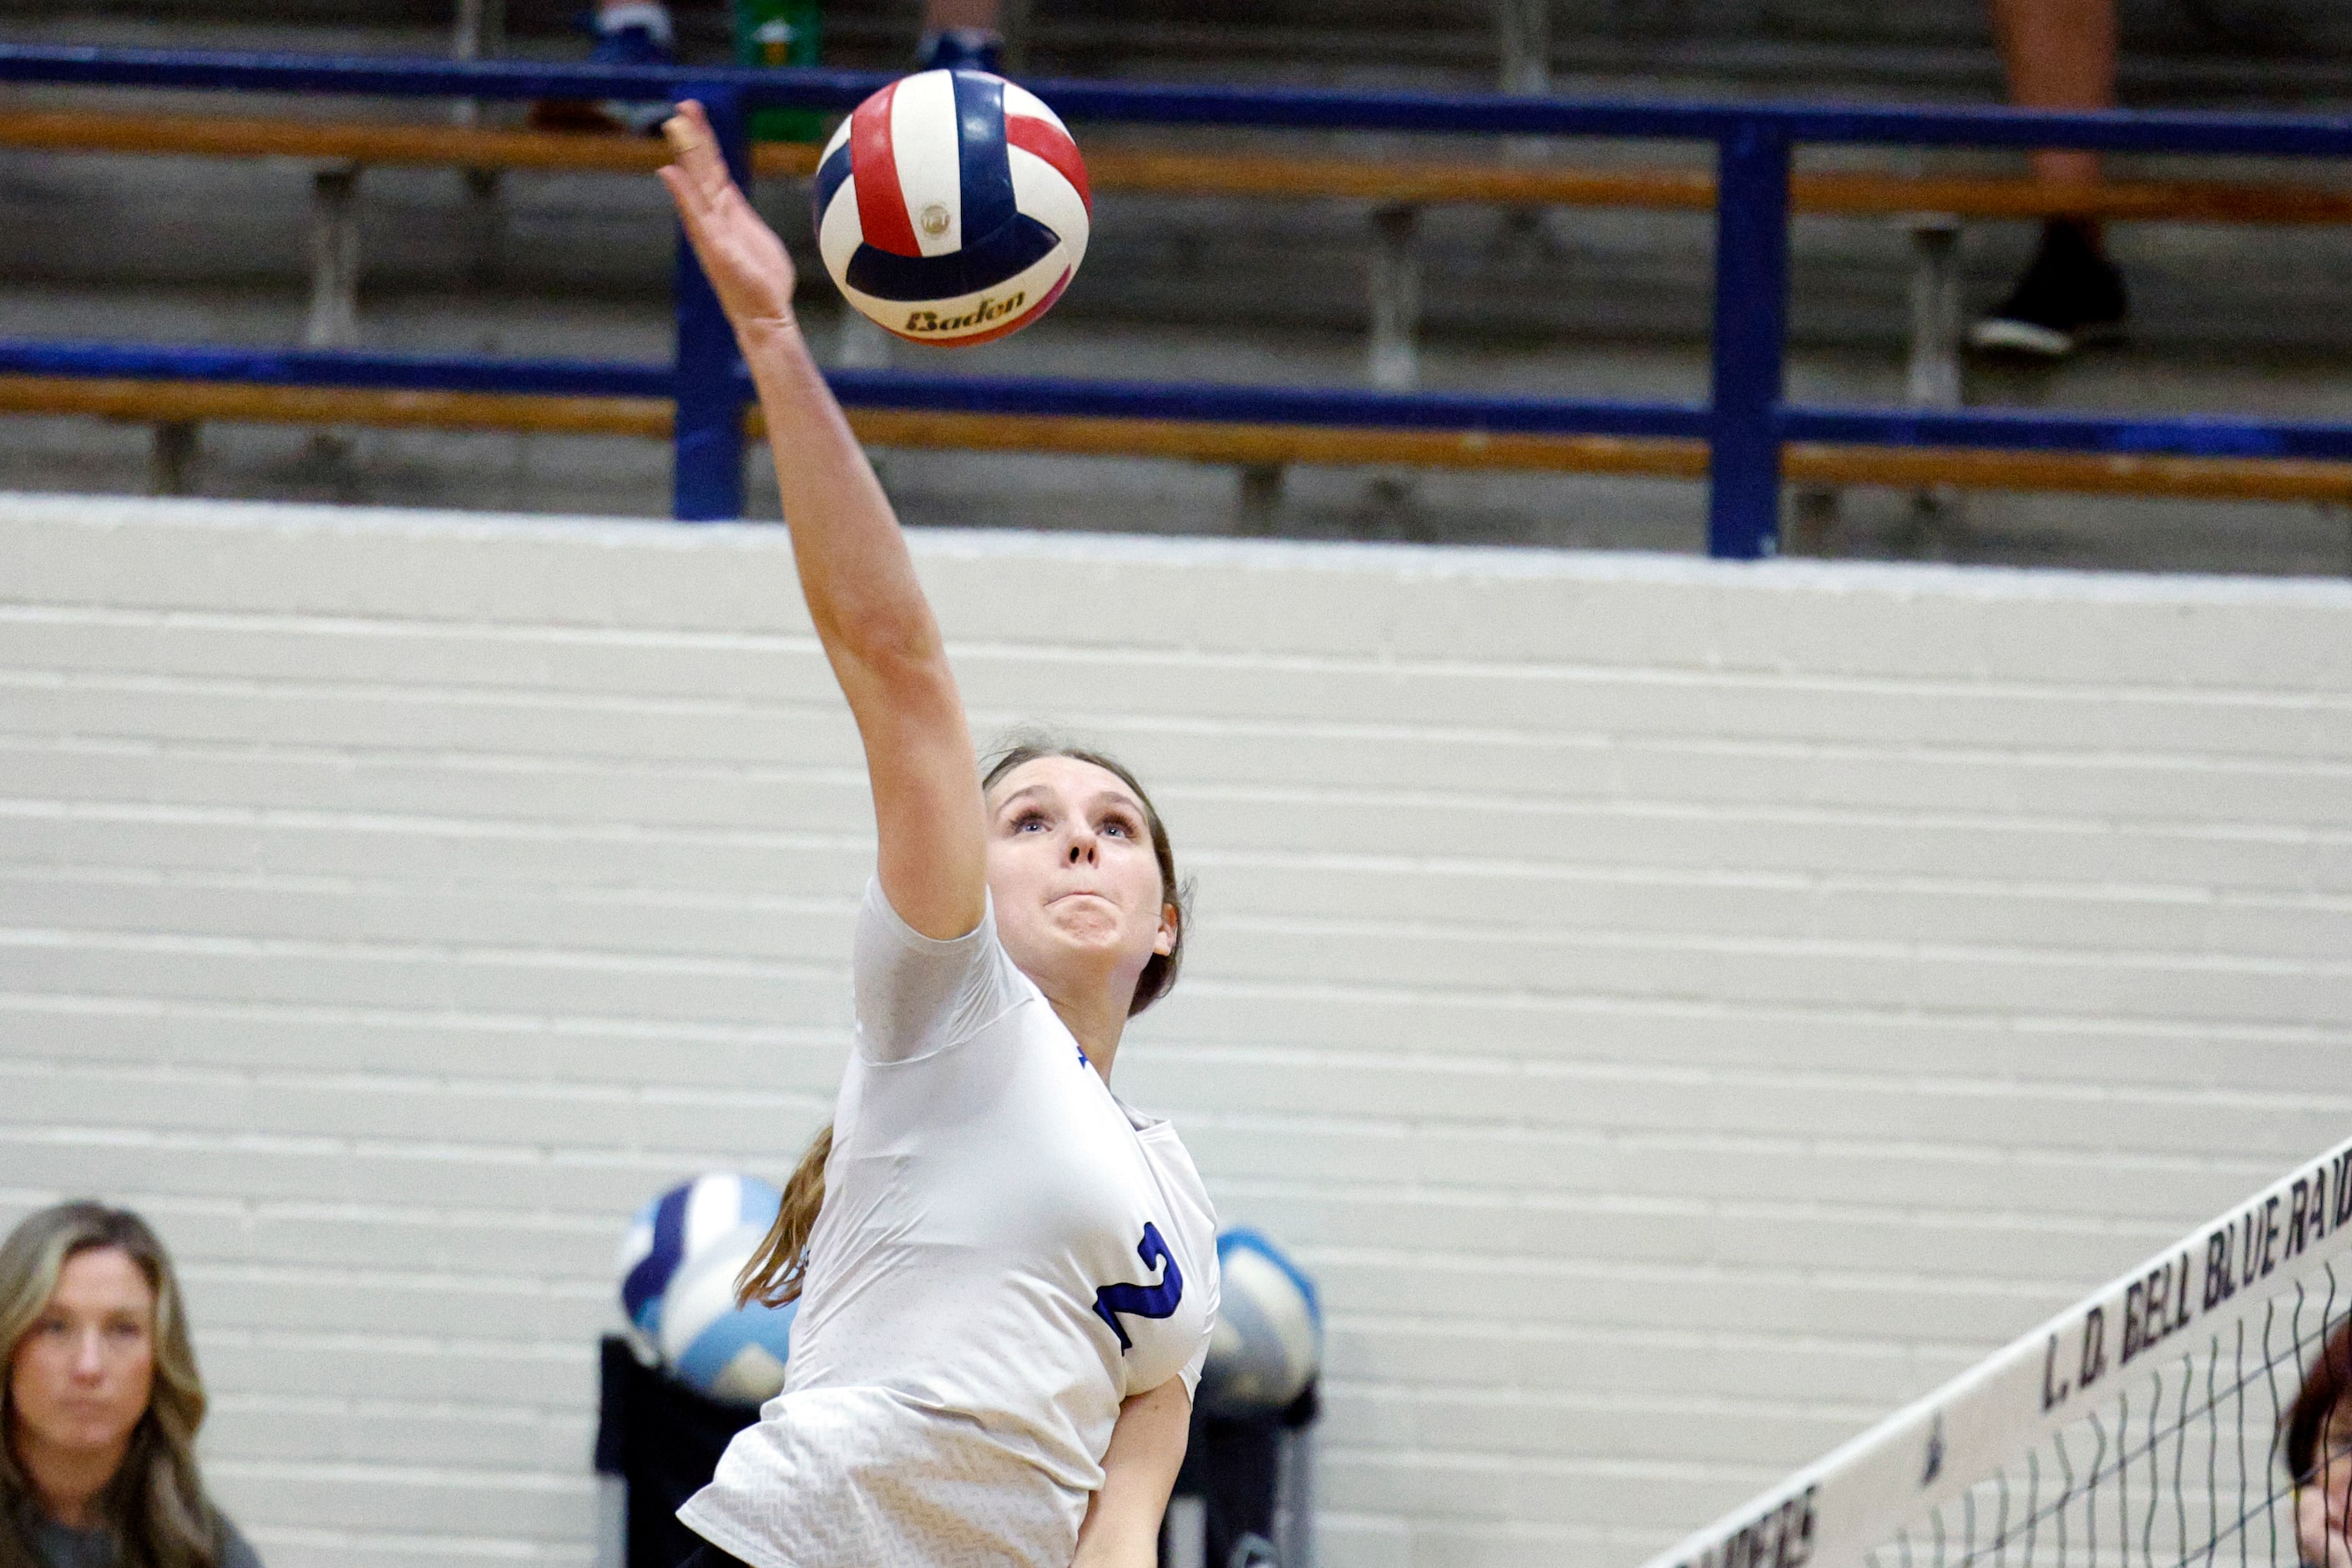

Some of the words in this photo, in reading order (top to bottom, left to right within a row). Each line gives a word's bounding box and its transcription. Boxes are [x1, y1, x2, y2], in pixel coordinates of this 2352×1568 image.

[906, 291, 1024, 331] Baden
[1092, 1222, 1183, 1357] 2
[2122, 1252, 2191, 1364] BELL
[2203, 1195, 2279, 1313] BLUE
